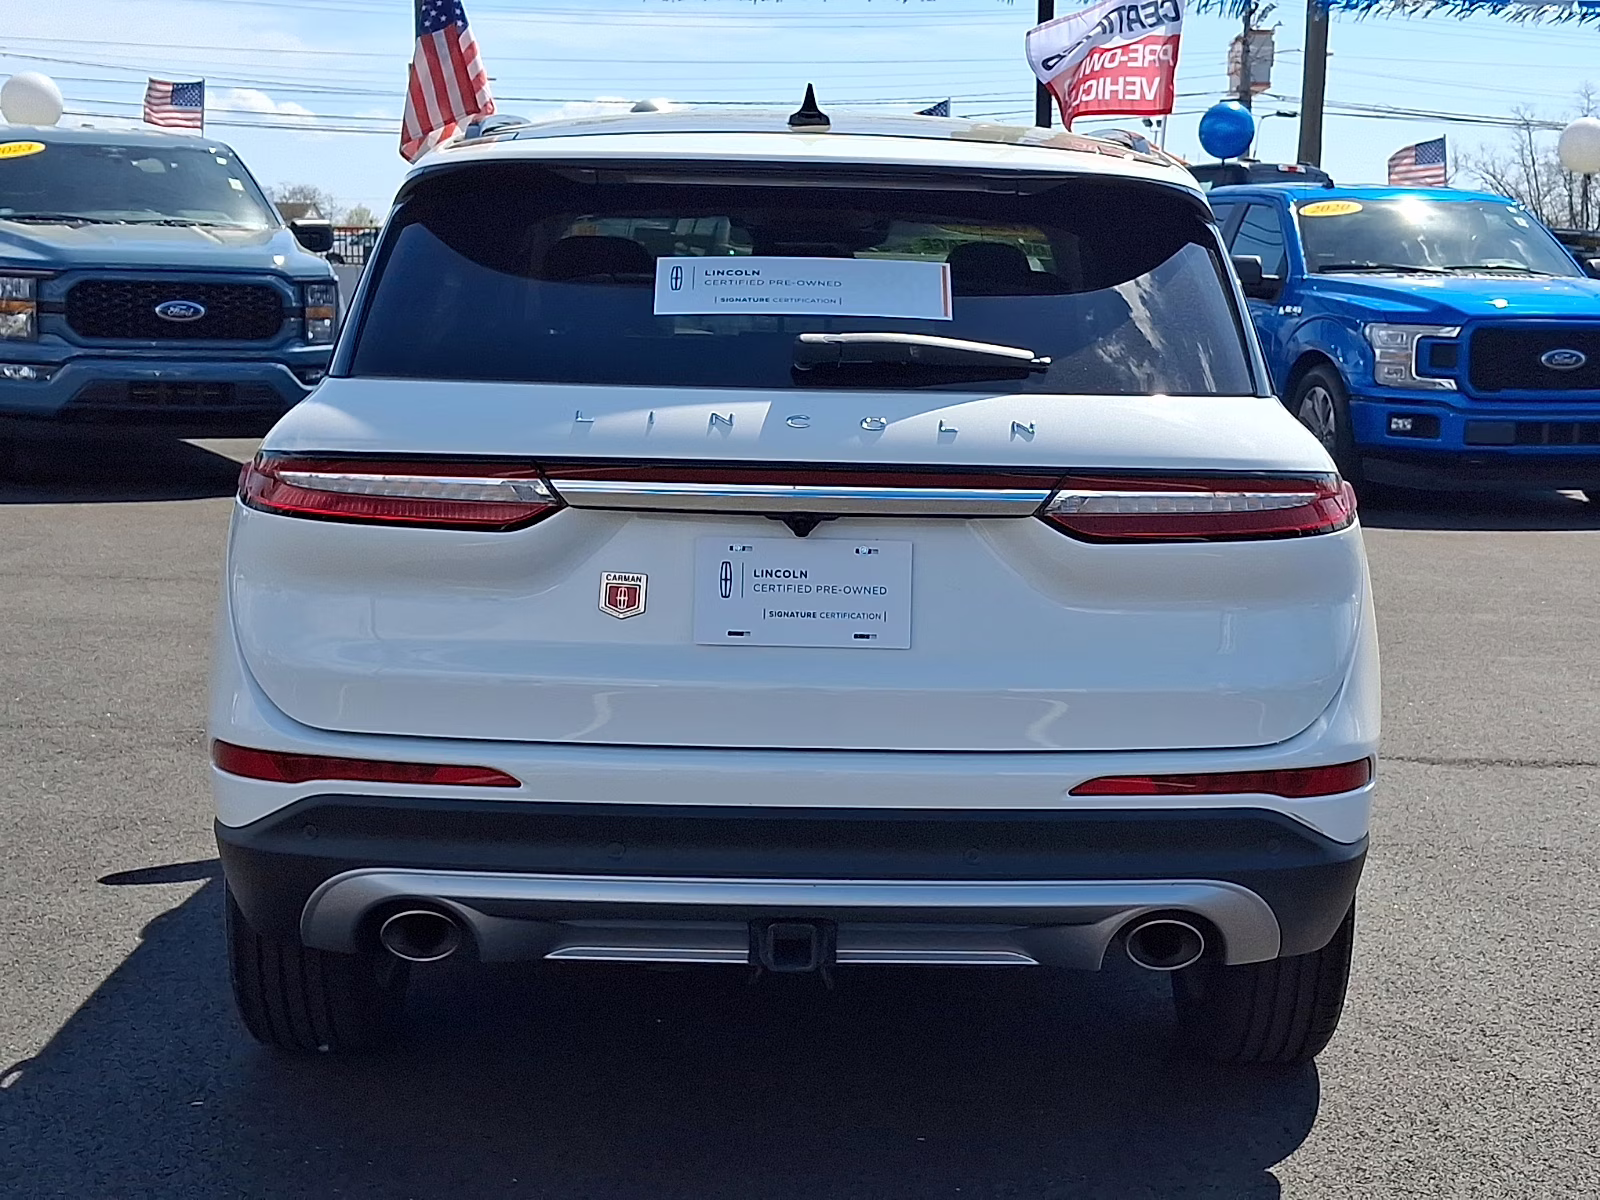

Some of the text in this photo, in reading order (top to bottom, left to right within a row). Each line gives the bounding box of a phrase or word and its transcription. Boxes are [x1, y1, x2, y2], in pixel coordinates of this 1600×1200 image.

[704, 269, 761, 277] LINCOLN
[704, 278, 842, 288] CERTIFIED PRE-OWNED
[575, 410, 1037, 442] LINCOLN
[605, 573, 643, 583] CARMAN
[753, 568, 808, 579] LINCOLN
[753, 583, 888, 596] CERTIFIED PRE-OWNED
[768, 610, 882, 620] SIGNATURE CERTIFICATION
